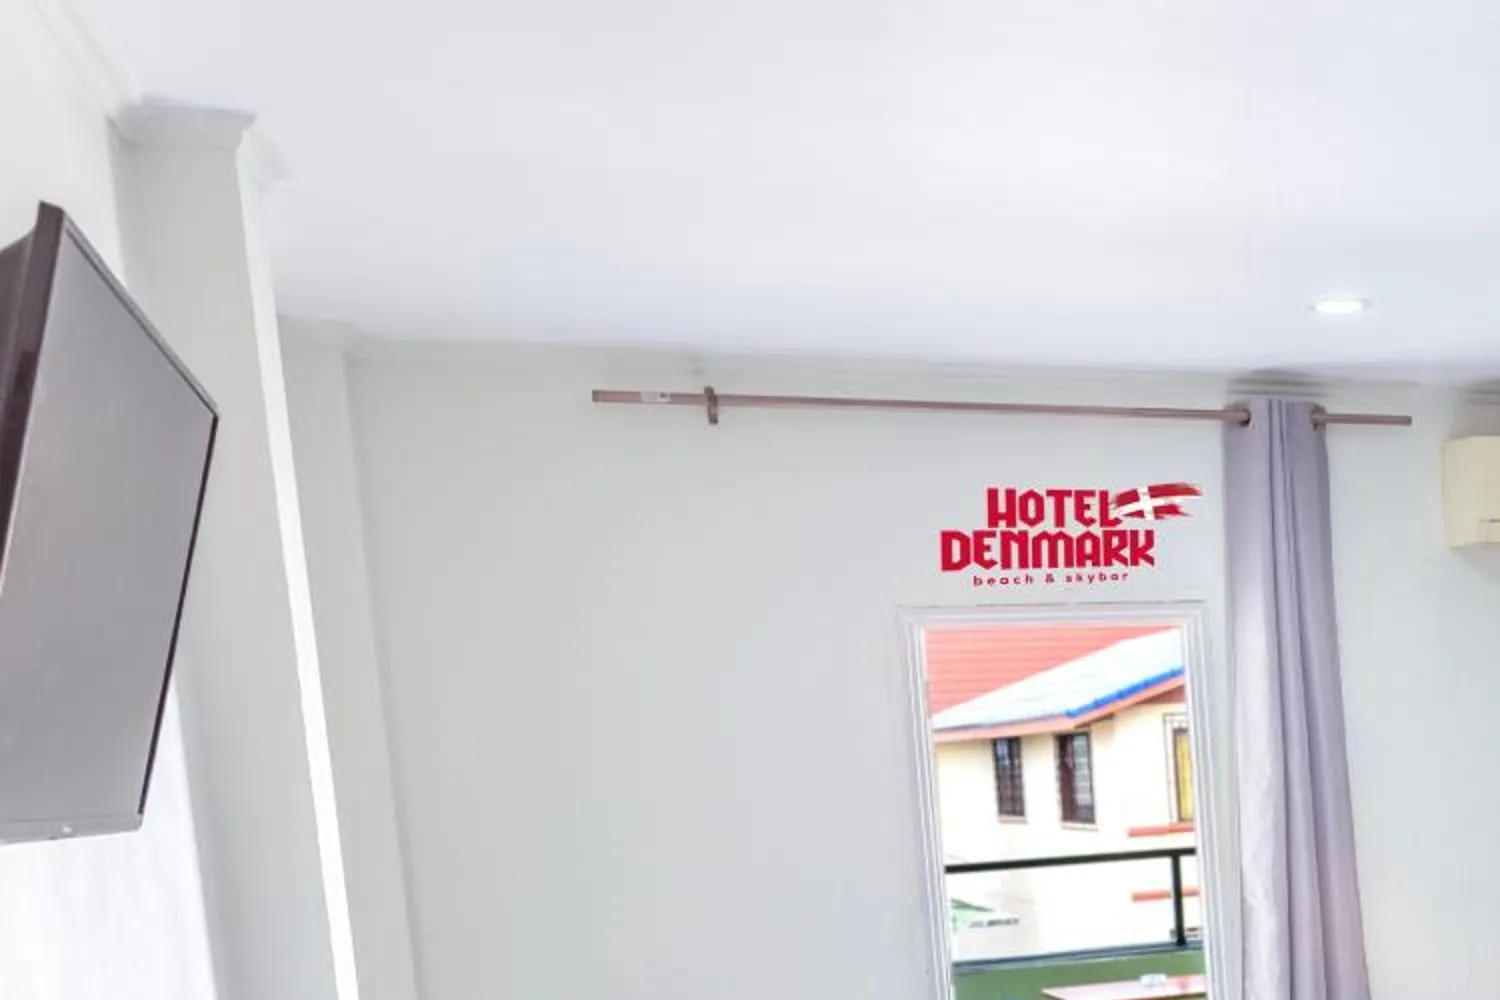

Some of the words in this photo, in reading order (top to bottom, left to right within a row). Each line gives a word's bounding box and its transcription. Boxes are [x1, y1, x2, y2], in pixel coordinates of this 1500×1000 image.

[987, 488, 1122, 529] HOTEL
[939, 529, 1156, 572] DENMARK
[973, 574, 1034, 587] beach
[1045, 573, 1055, 584] &
[1064, 572, 1130, 584] skybar
